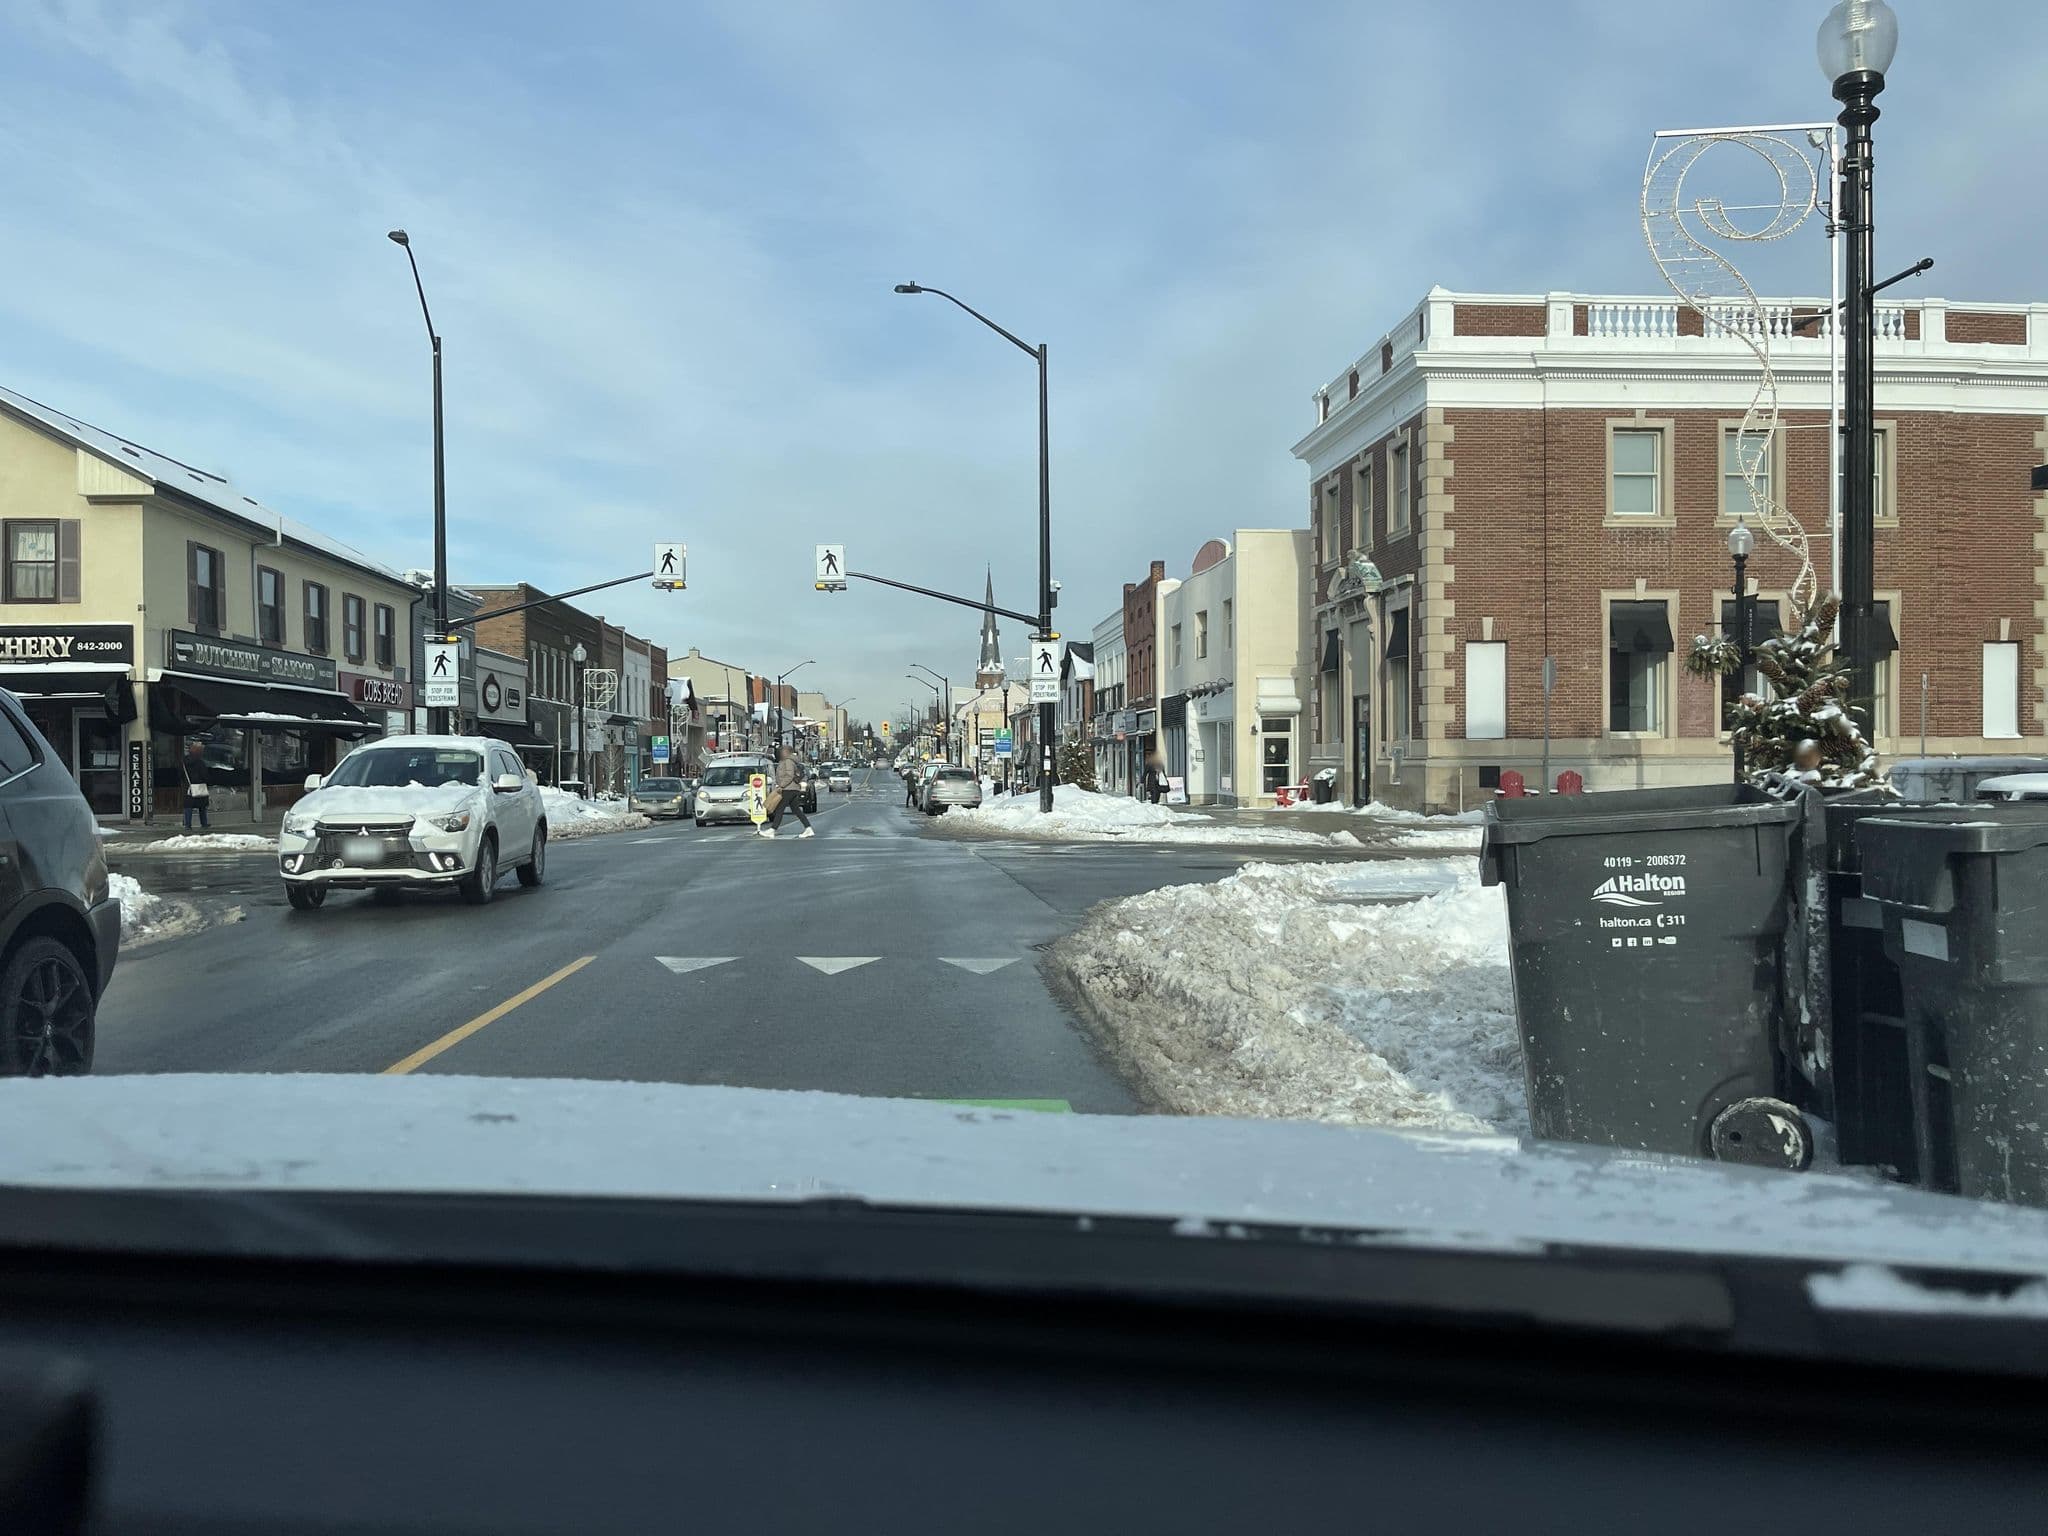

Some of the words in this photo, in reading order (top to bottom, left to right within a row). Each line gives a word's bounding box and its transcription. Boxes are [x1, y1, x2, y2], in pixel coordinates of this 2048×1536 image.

[77, 641, 123, 650] 842-2000
[195, 643, 260, 672] BUTCHERY
[271, 657, 316, 681] SEAFOOD
[363, 679, 381, 702] COBS
[382, 681, 404, 704] BREAD
[132, 753, 141, 813] SEAFOOD
[1603, 856, 1632, 868] 40119
[1646, 854, 1686, 866] 2006372
[1619, 873, 1685, 892] Halton
[1600, 917, 1652, 928] halton.ca
[1666, 915, 1685, 925] 311
